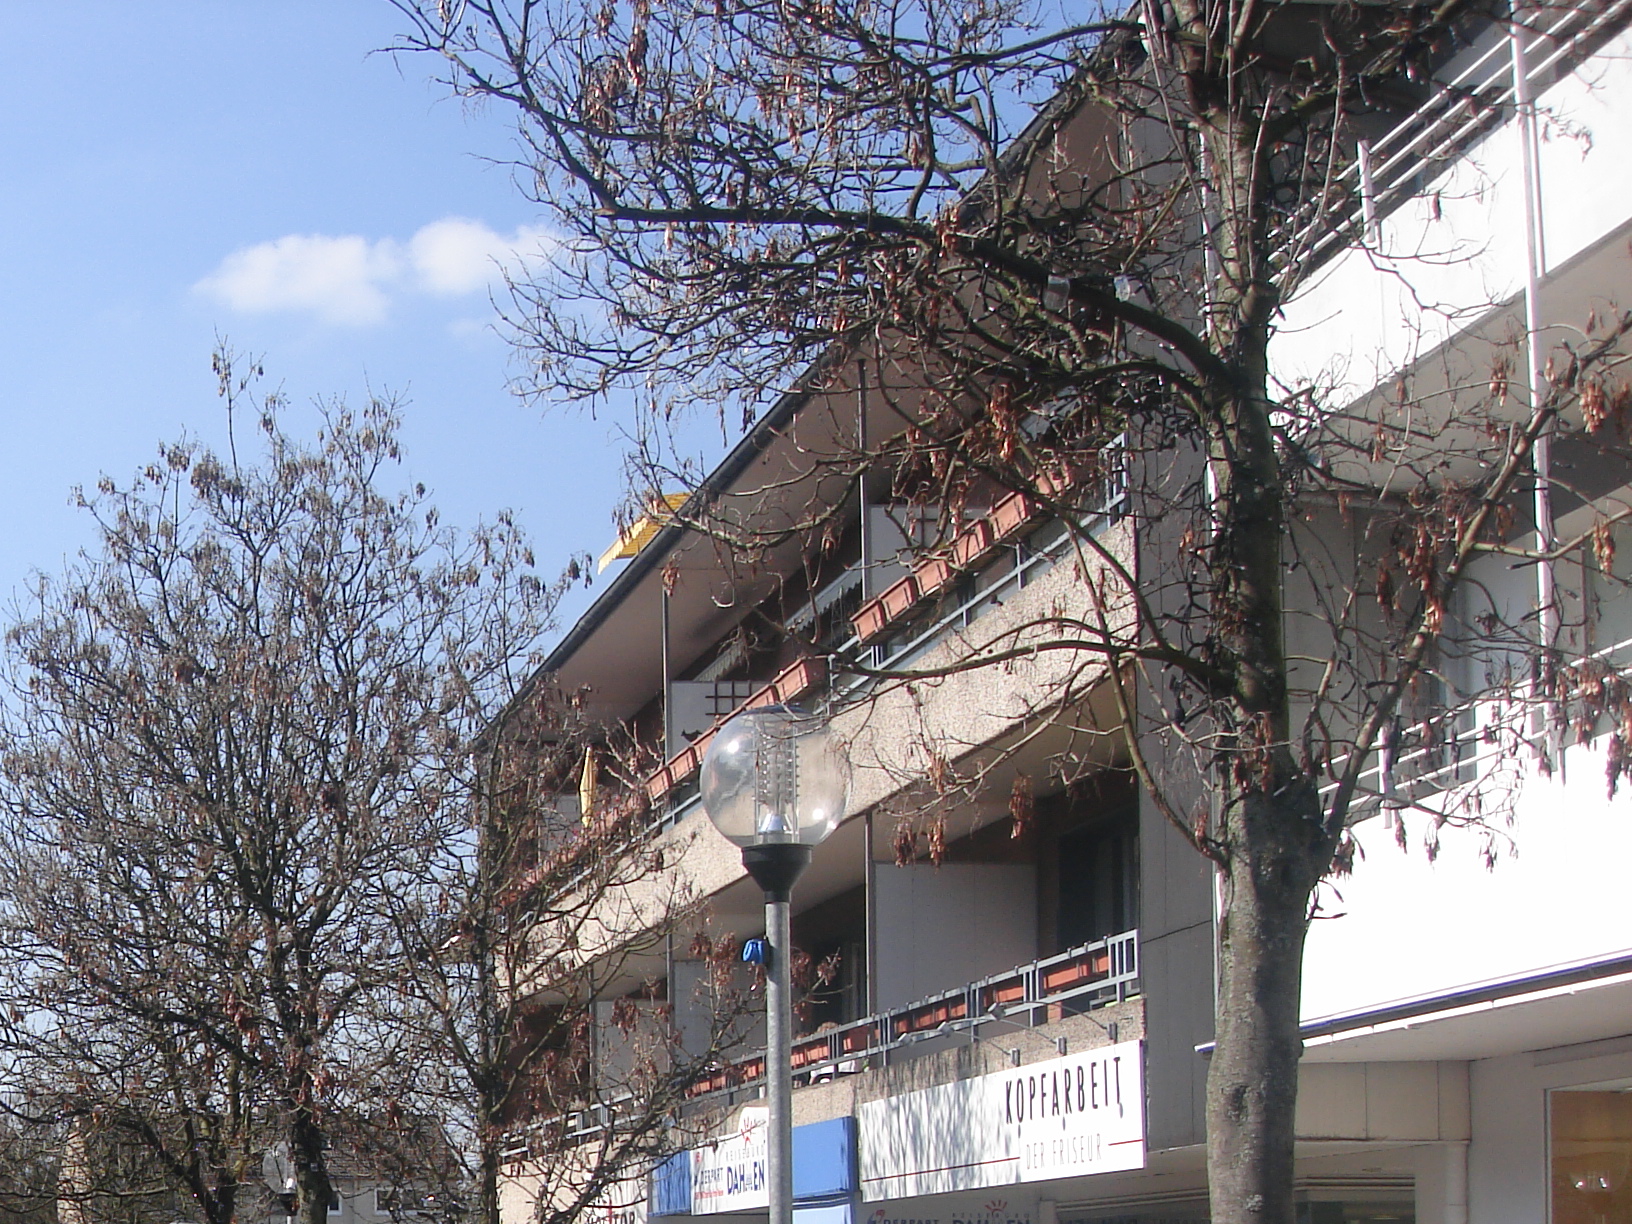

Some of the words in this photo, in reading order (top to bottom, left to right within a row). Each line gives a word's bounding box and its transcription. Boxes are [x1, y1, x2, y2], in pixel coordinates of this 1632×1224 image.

[1005, 1056, 1121, 1125] KOPFARBEIT
[1026, 1141, 1046, 1169] DER
[1052, 1133, 1102, 1166] FRISEUR
[727, 1158, 765, 1196] DAHMEN
